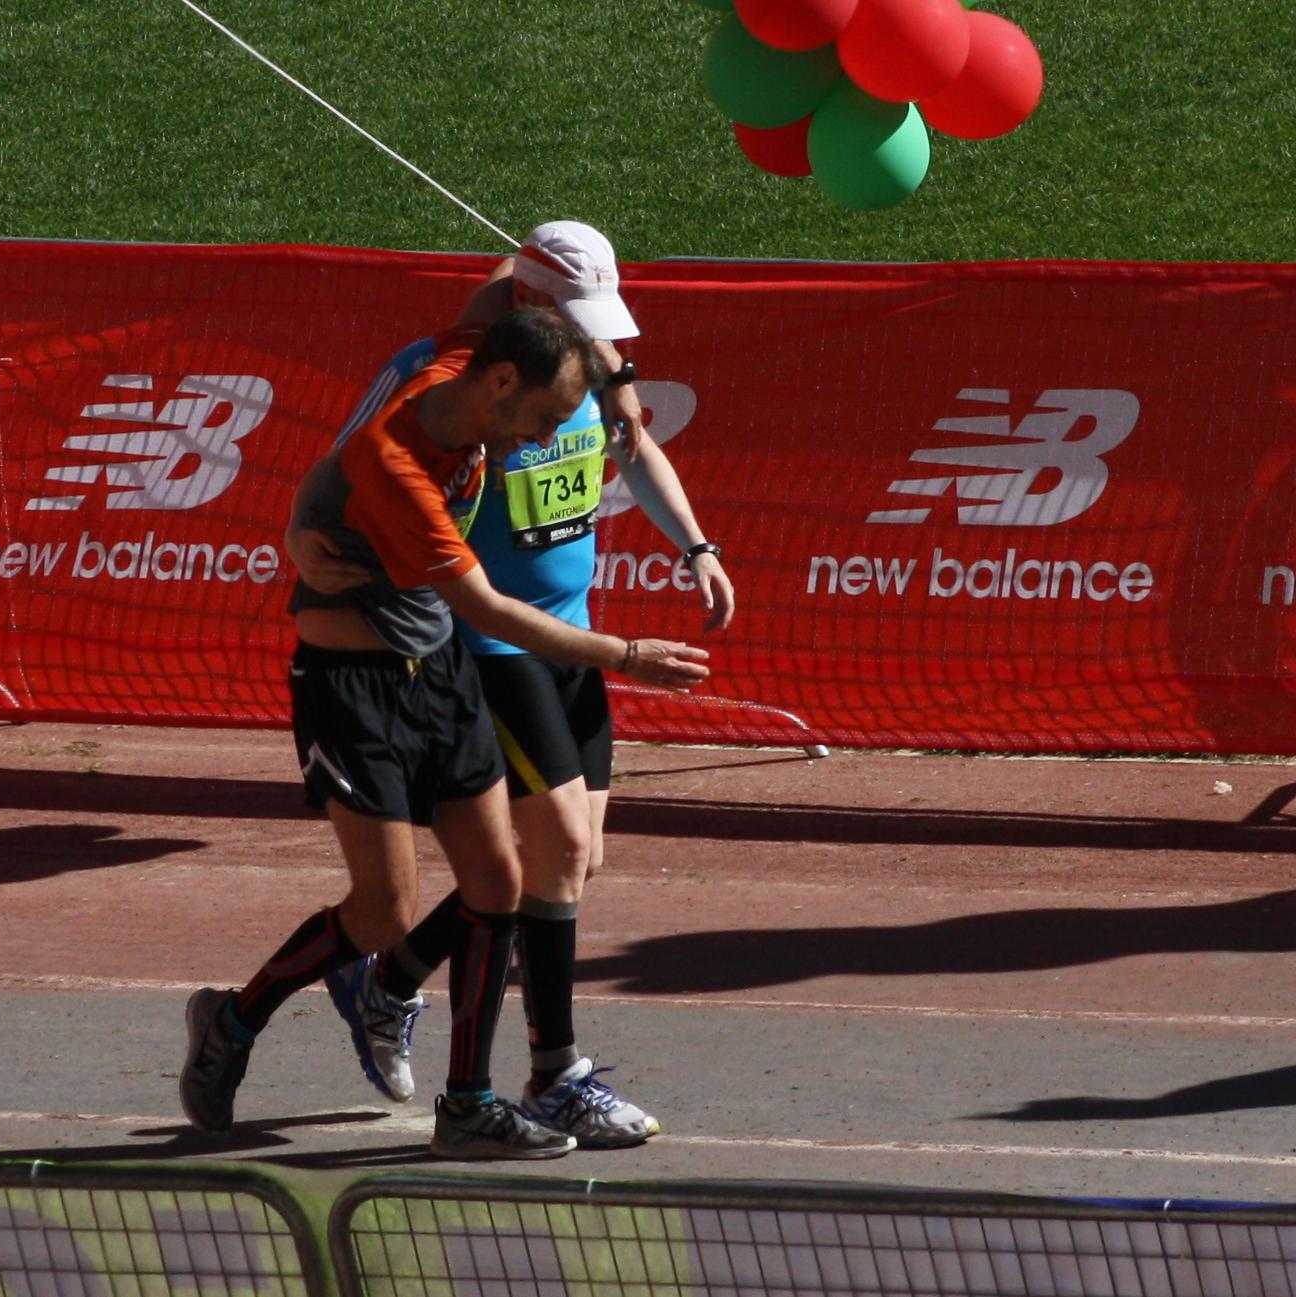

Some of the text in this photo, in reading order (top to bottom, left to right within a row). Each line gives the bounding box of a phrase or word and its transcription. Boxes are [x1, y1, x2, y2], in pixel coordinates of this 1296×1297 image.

[520, 444, 558, 467] Sport
[564, 432, 597, 455] Life
[537, 469, 587, 506] 734
[78, 532, 278, 584] balance
[807, 547, 1153, 601] new balance
